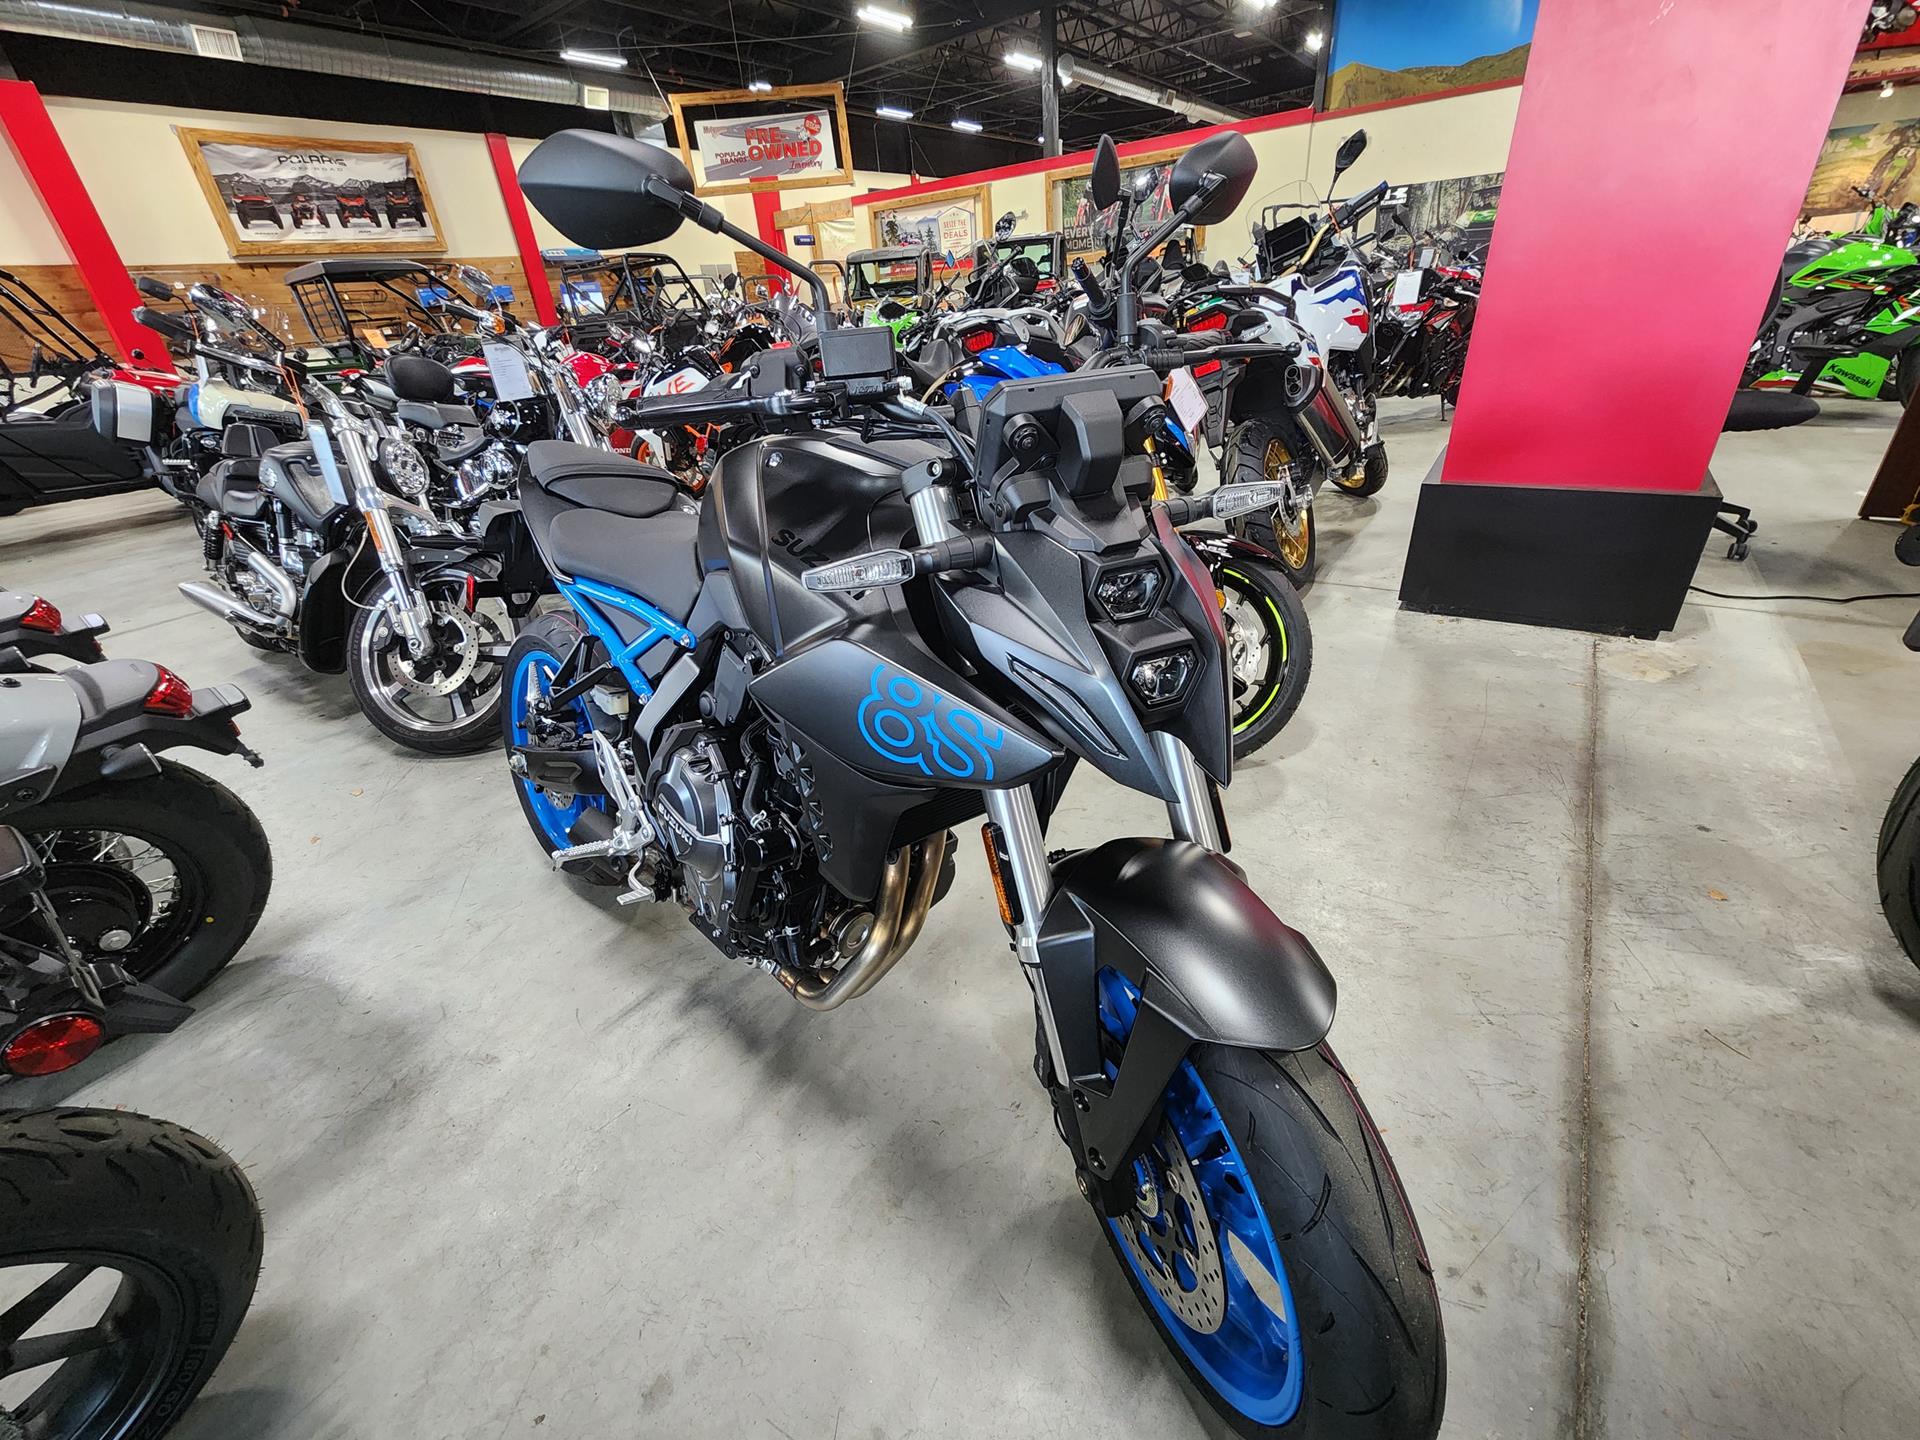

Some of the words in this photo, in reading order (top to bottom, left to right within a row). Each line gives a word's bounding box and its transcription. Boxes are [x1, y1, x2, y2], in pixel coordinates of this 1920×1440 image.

[715, 151, 746, 159] POPULAR
[748, 139, 822, 161] OWNED
[278, 154, 347, 167] POLARIS
[943, 230, 968, 239] DEALS
[1827, 363, 1876, 388] Kawasaki
[659, 803, 693, 846] SUZUKI
